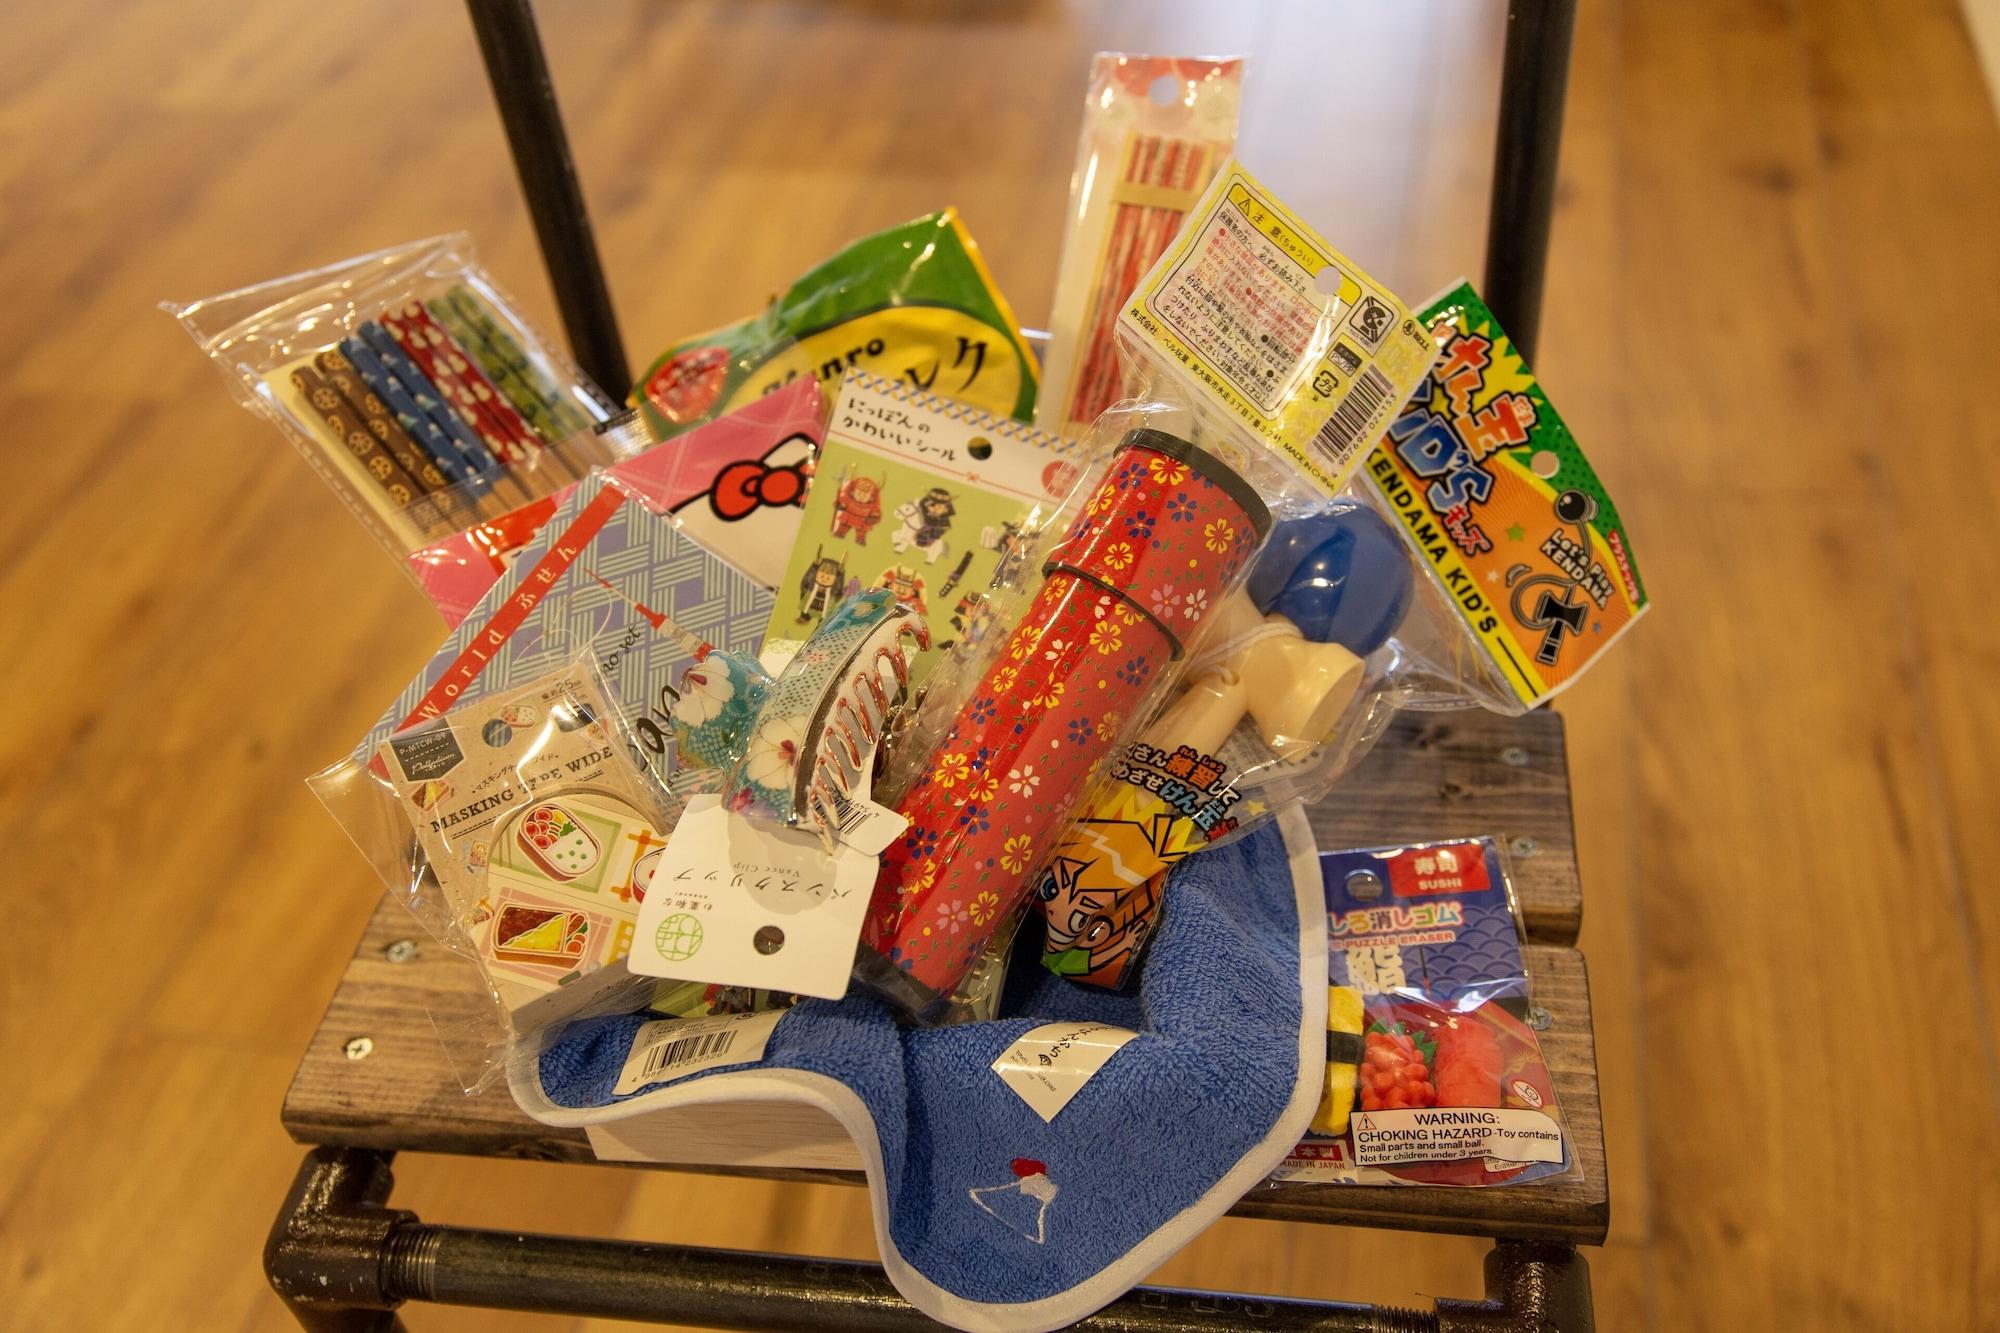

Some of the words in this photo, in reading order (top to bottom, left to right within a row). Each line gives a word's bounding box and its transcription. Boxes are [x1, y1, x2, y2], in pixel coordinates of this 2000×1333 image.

[848, 396, 932, 435] にっぽんの
[842, 415, 957, 463] かわいいシール
[1541, 542, 1610, 611] KENDAMA
[1445, 562, 1497, 634] KID'S
[419, 629, 505, 720] World
[516, 544, 577, 611] ふせん
[431, 781, 515, 834] MASKING
[565, 745, 614, 773] WIDE
[1414, 851, 1458, 875] 寿司
[673, 866, 853, 900] バンスクリップ
[1418, 877, 1462, 891] SUSHI
[1346, 937, 1396, 949] PUZZLE
[1400, 932, 1454, 944] ERASER
[1414, 1112, 1500, 1126] WARNING:
[1358, 1130, 1428, 1143] CHOKING
[1432, 1127, 1492, 1140] HAZARD
[1518, 1131, 1559, 1141] contains
[1359, 1144, 1386, 1153] Small
[1388, 1143, 1415, 1152] parts
[1417, 1141, 1436, 1150] and
[1438, 1140, 1463, 1149] small
[1318, 1160, 1345, 1169] JAPAN
[1360, 1154, 1376, 1163] Not
[1378, 1153, 1390, 1161] for
[1394, 1151, 1428, 1160] children
[1431, 1150, 1457, 1159] under
